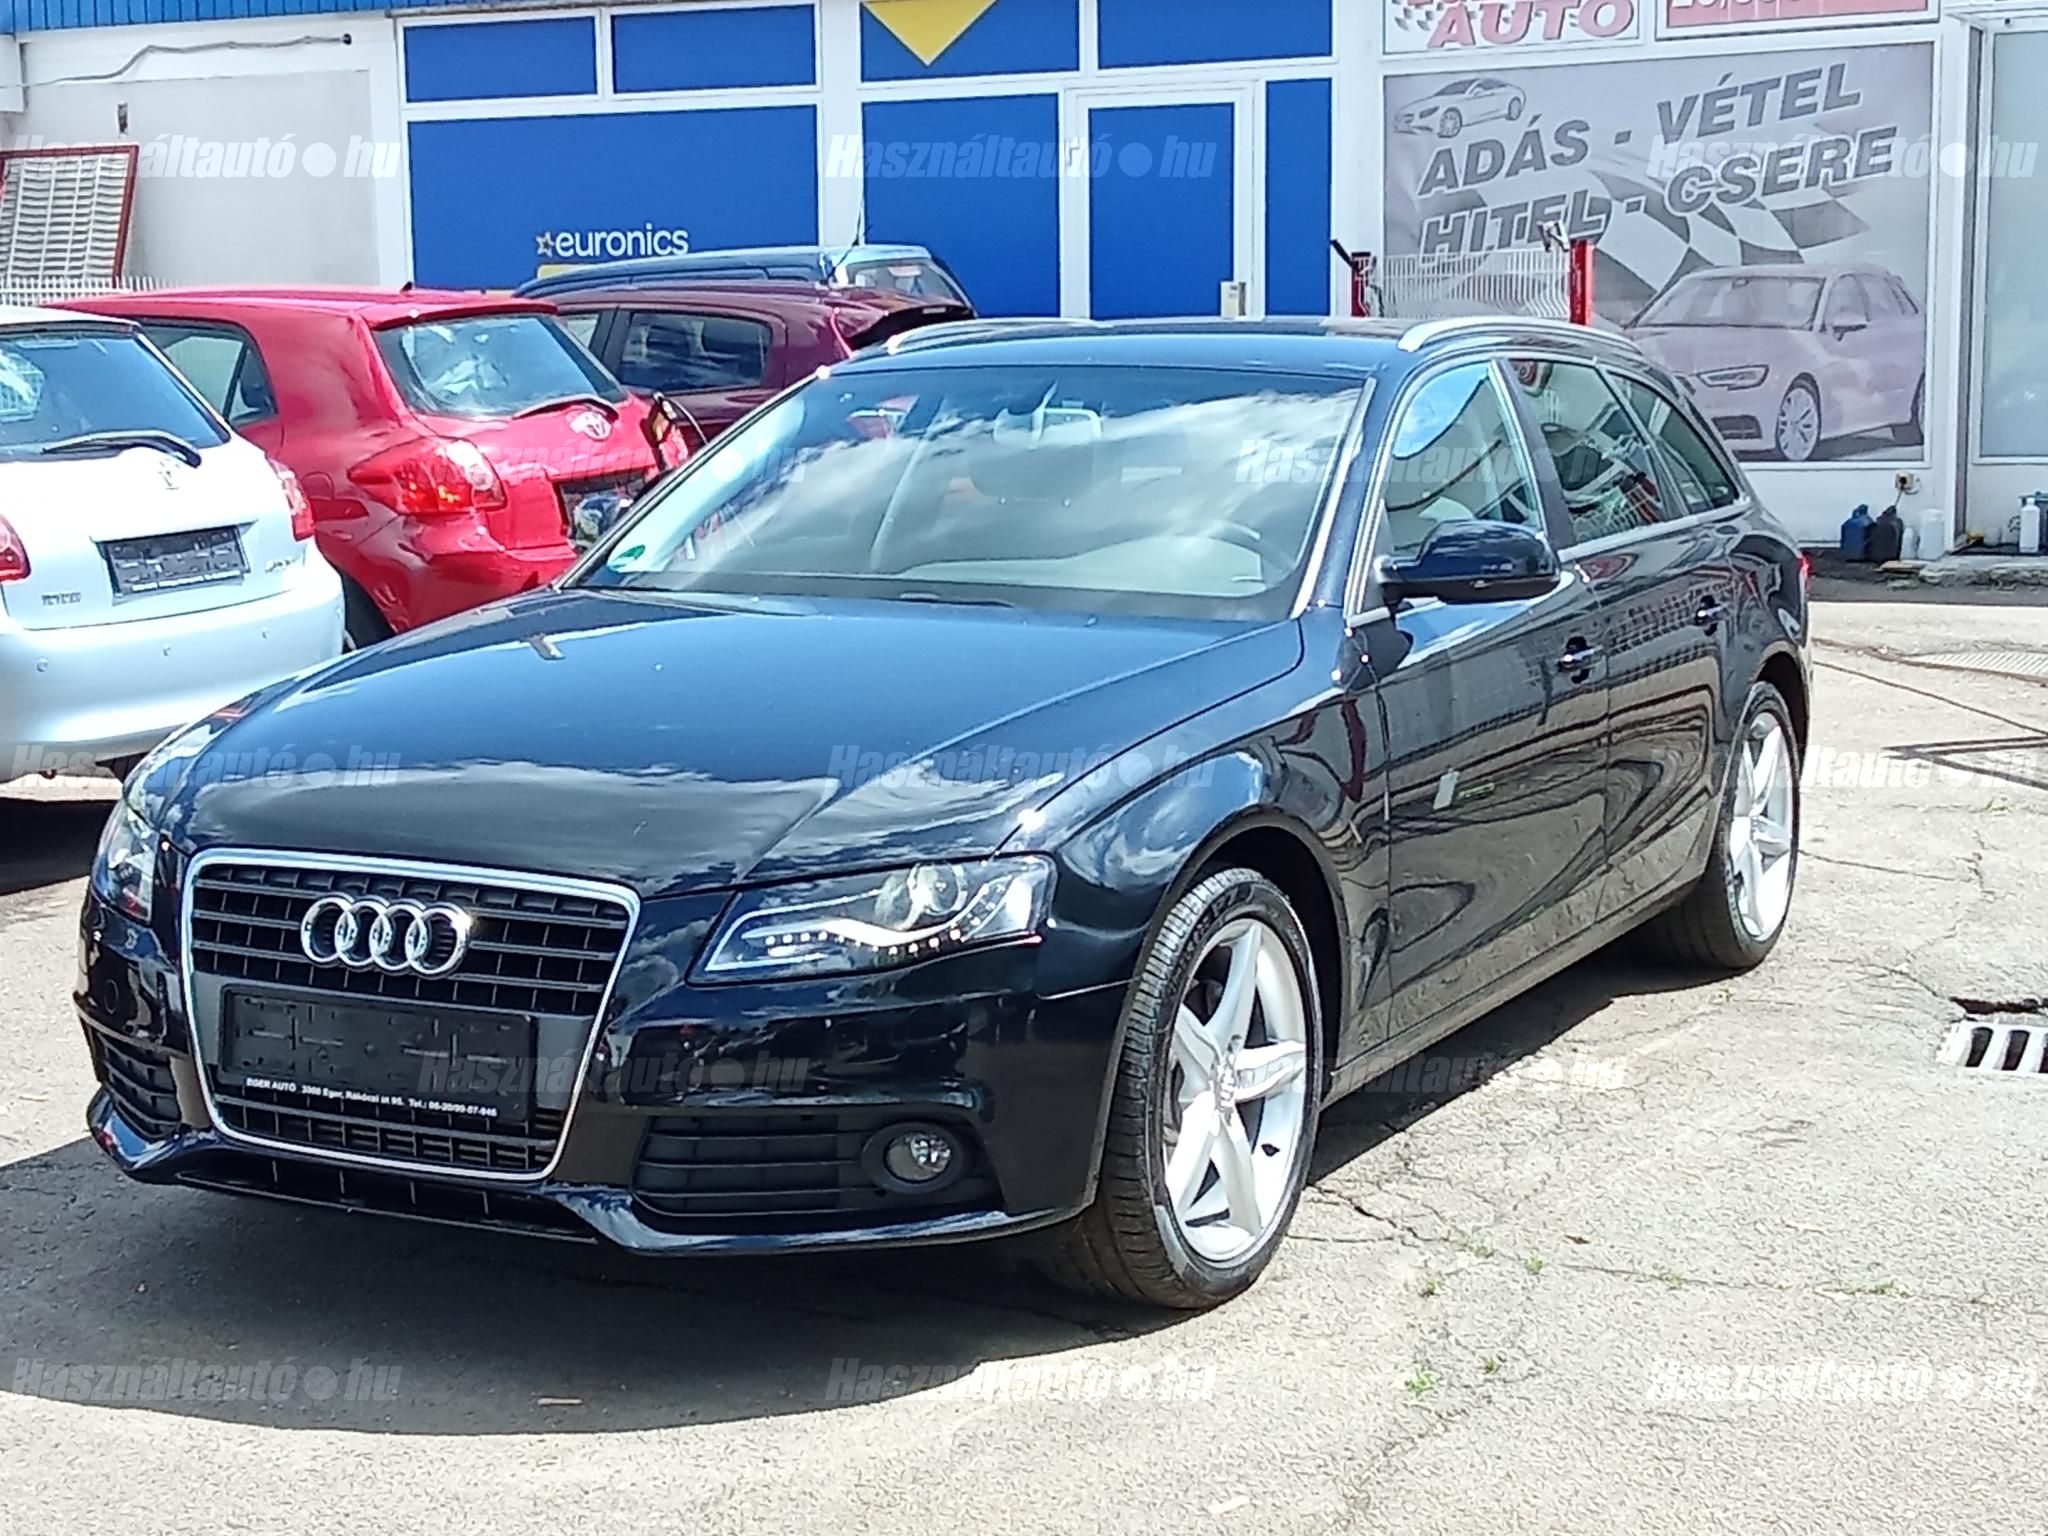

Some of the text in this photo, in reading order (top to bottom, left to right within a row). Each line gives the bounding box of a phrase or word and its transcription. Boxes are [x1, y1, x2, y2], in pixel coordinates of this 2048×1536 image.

[1418, 113, 1591, 197] ADÁS
[1656, 63, 1862, 145] VÉTEL
[1419, 187, 1609, 258] HITEL
[1667, 125, 1899, 215] CSERE
[555, 222, 690, 257] euronics
